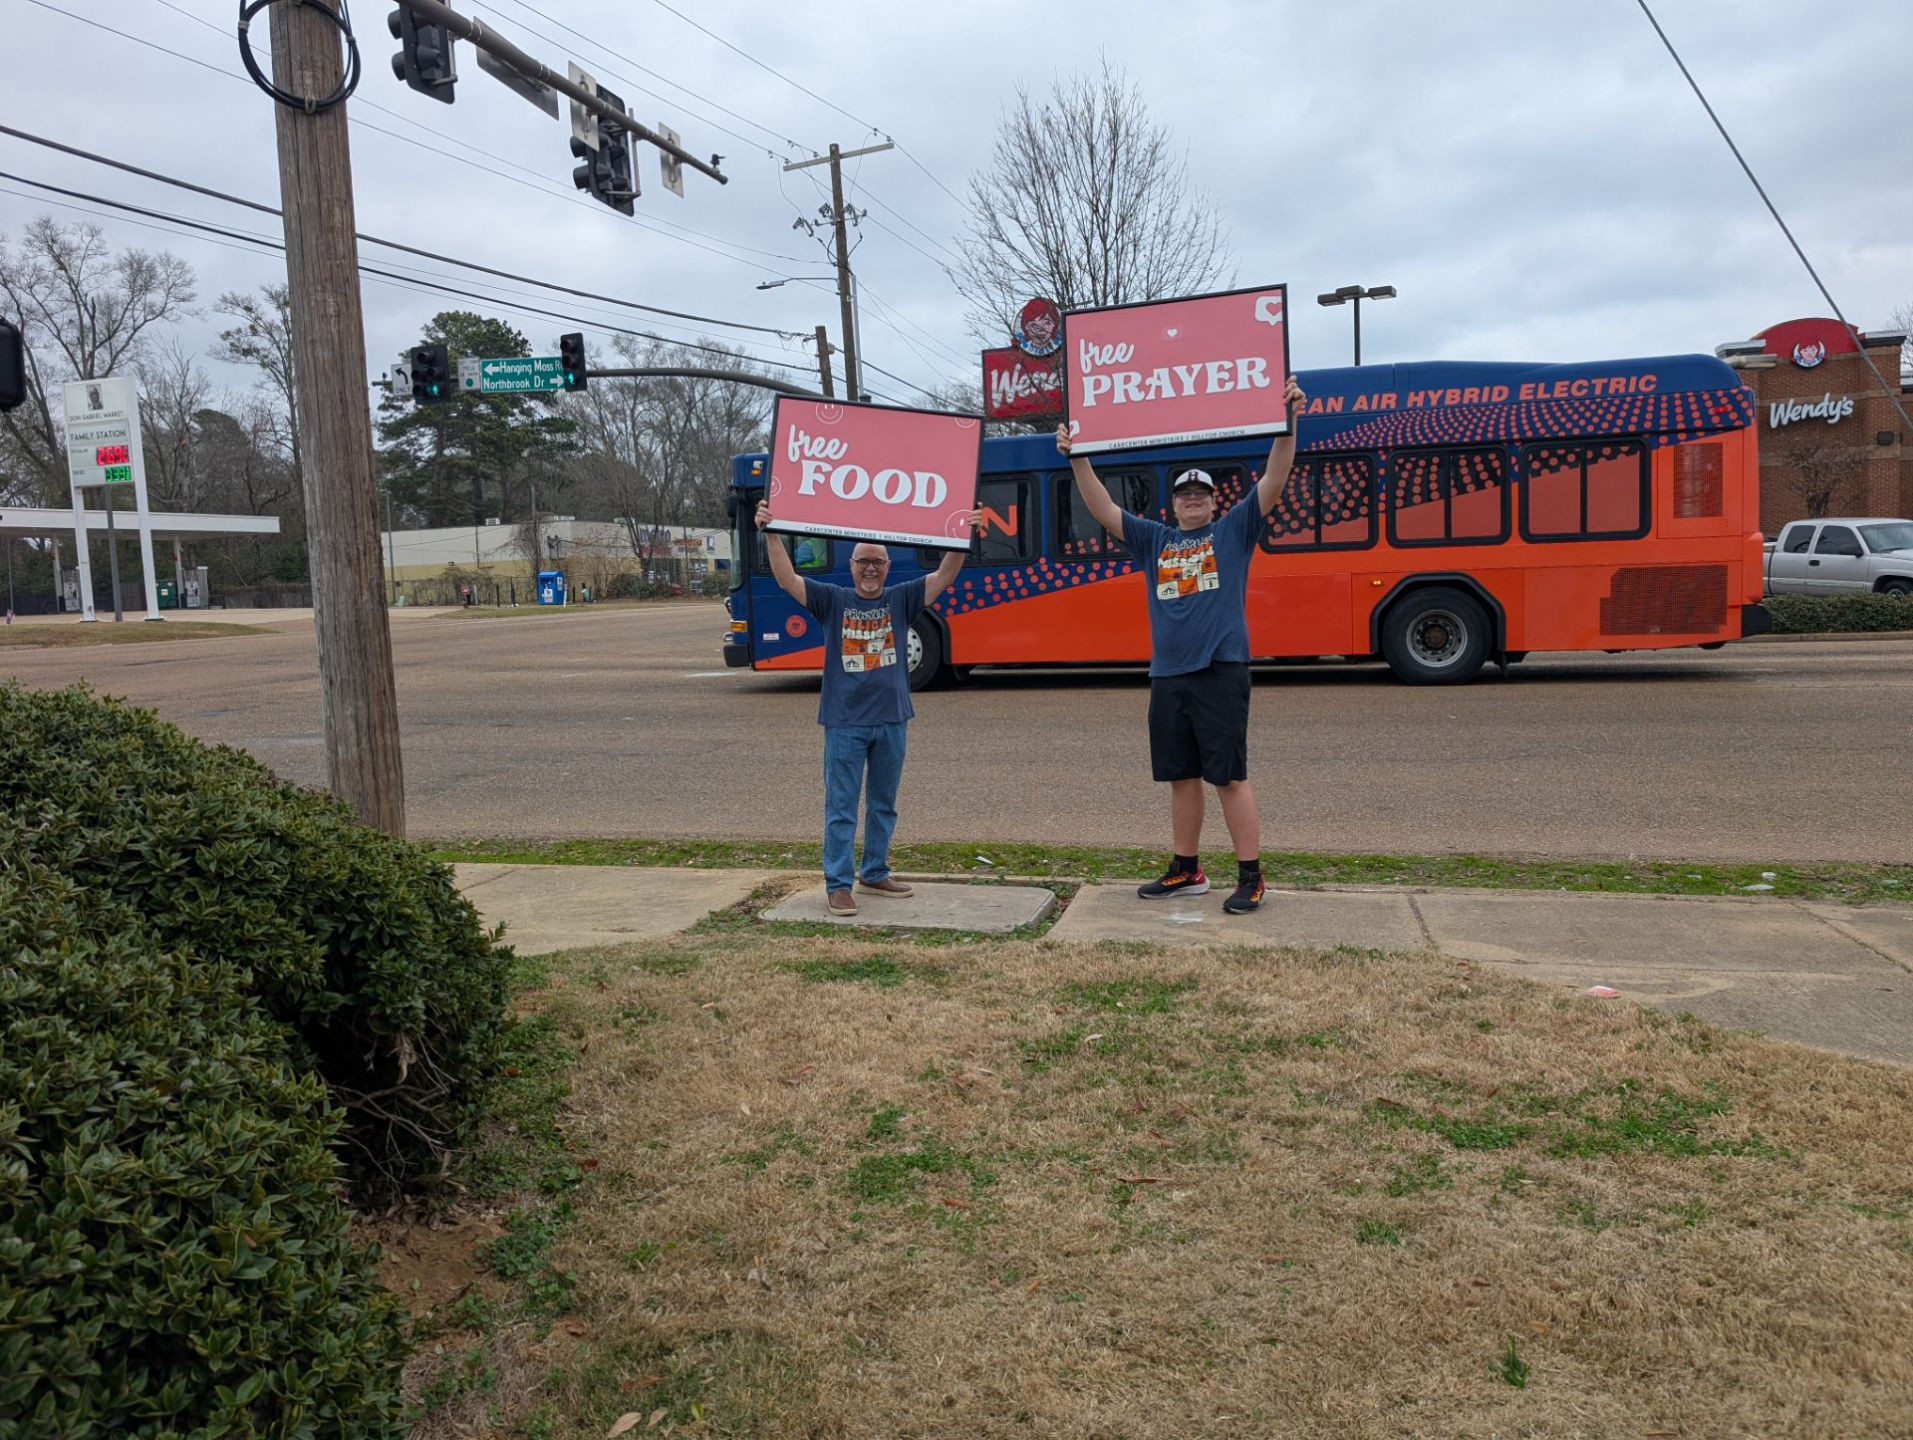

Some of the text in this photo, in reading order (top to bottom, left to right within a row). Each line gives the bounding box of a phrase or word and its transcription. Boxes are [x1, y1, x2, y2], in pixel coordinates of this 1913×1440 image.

[500, 361, 532, 375] Hanging
[534, 360, 554, 372] Moss
[1079, 338, 1135, 374] free
[482, 376, 545, 390] Northbrook Dr
[1082, 357, 1271, 408] PRAYER
[1352, 393, 1397, 411] AIR
[1407, 385, 1509, 408] HYBRID
[1519, 374, 1659, 401] ELECTRIC
[103, 410, 124, 418] MARKET
[1769, 392, 1854, 429] Wendy's
[70, 428, 126, 441] FAMILY STATION
[788, 424, 849, 463] free
[798, 459, 948, 508] FOOD
